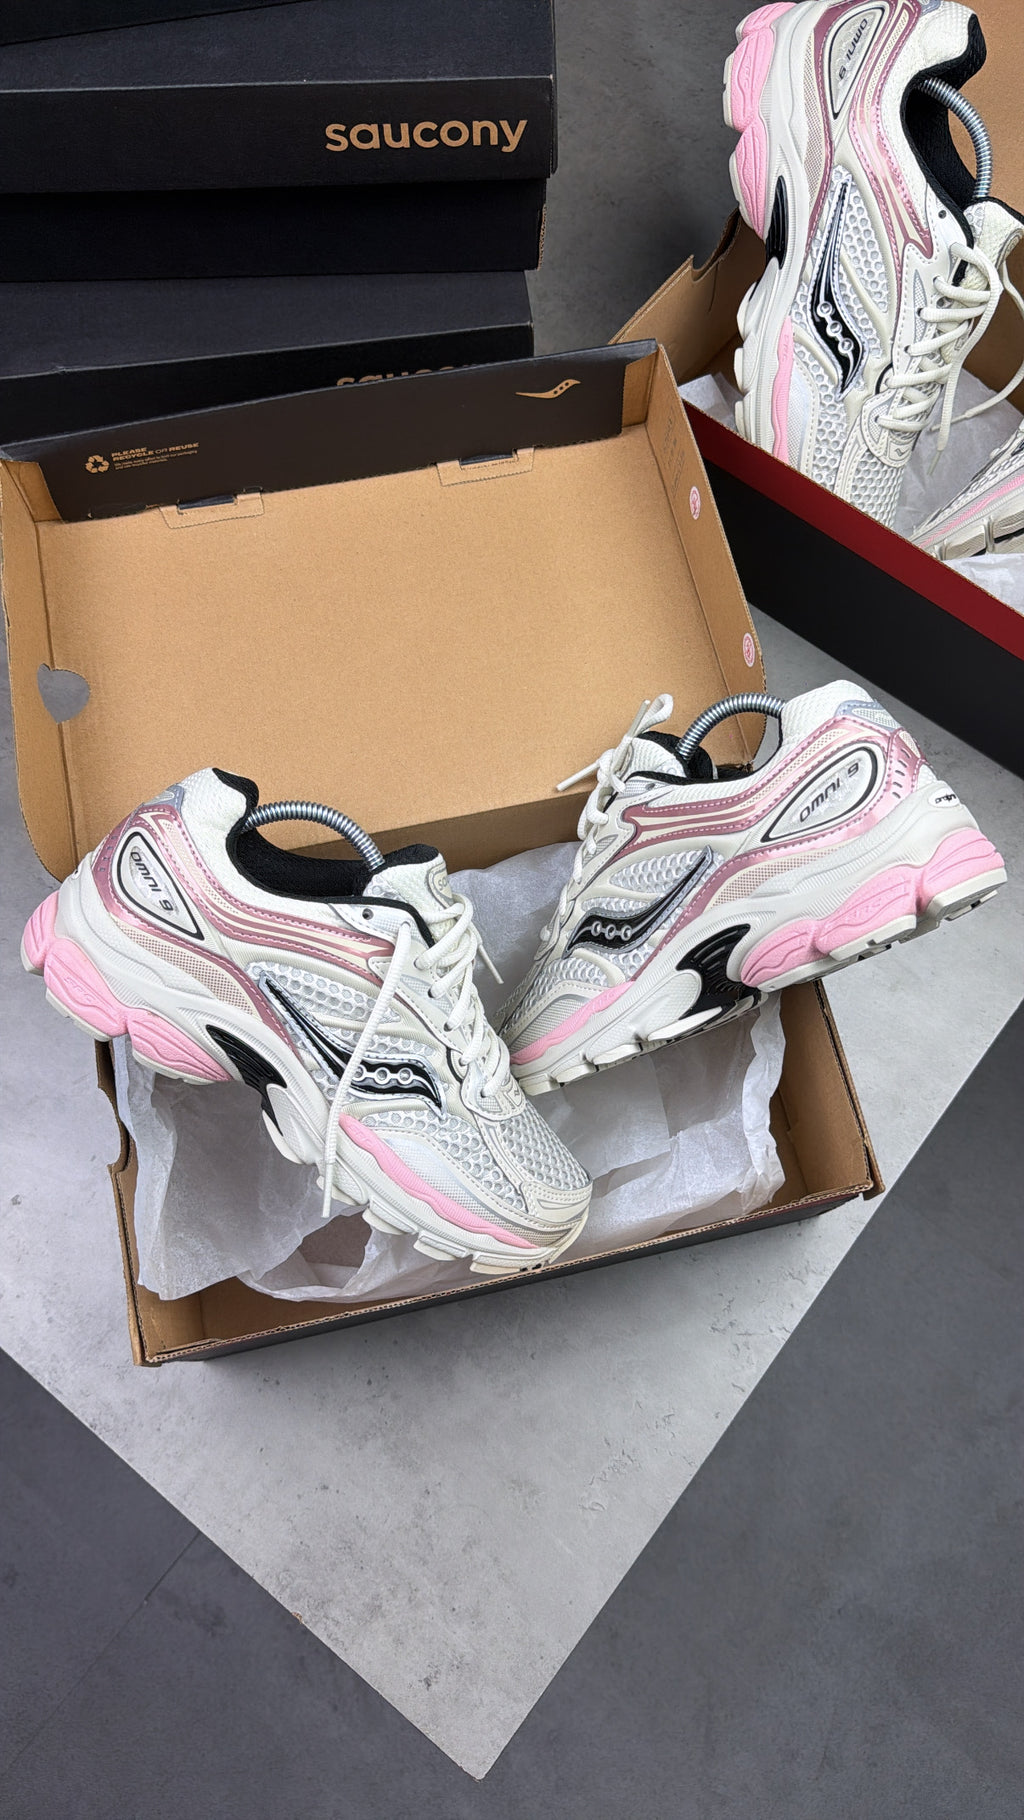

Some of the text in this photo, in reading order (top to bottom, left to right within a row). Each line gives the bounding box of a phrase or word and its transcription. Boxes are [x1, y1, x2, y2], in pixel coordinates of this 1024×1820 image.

[325, 119, 528, 153] saucony
[111, 447, 148, 458] PLEASE
[112, 450, 154, 462] RECYCLE
[168, 442, 200, 453] REUSE
[847, 762, 859, 778] 9
[159, 899, 174, 911] 9
